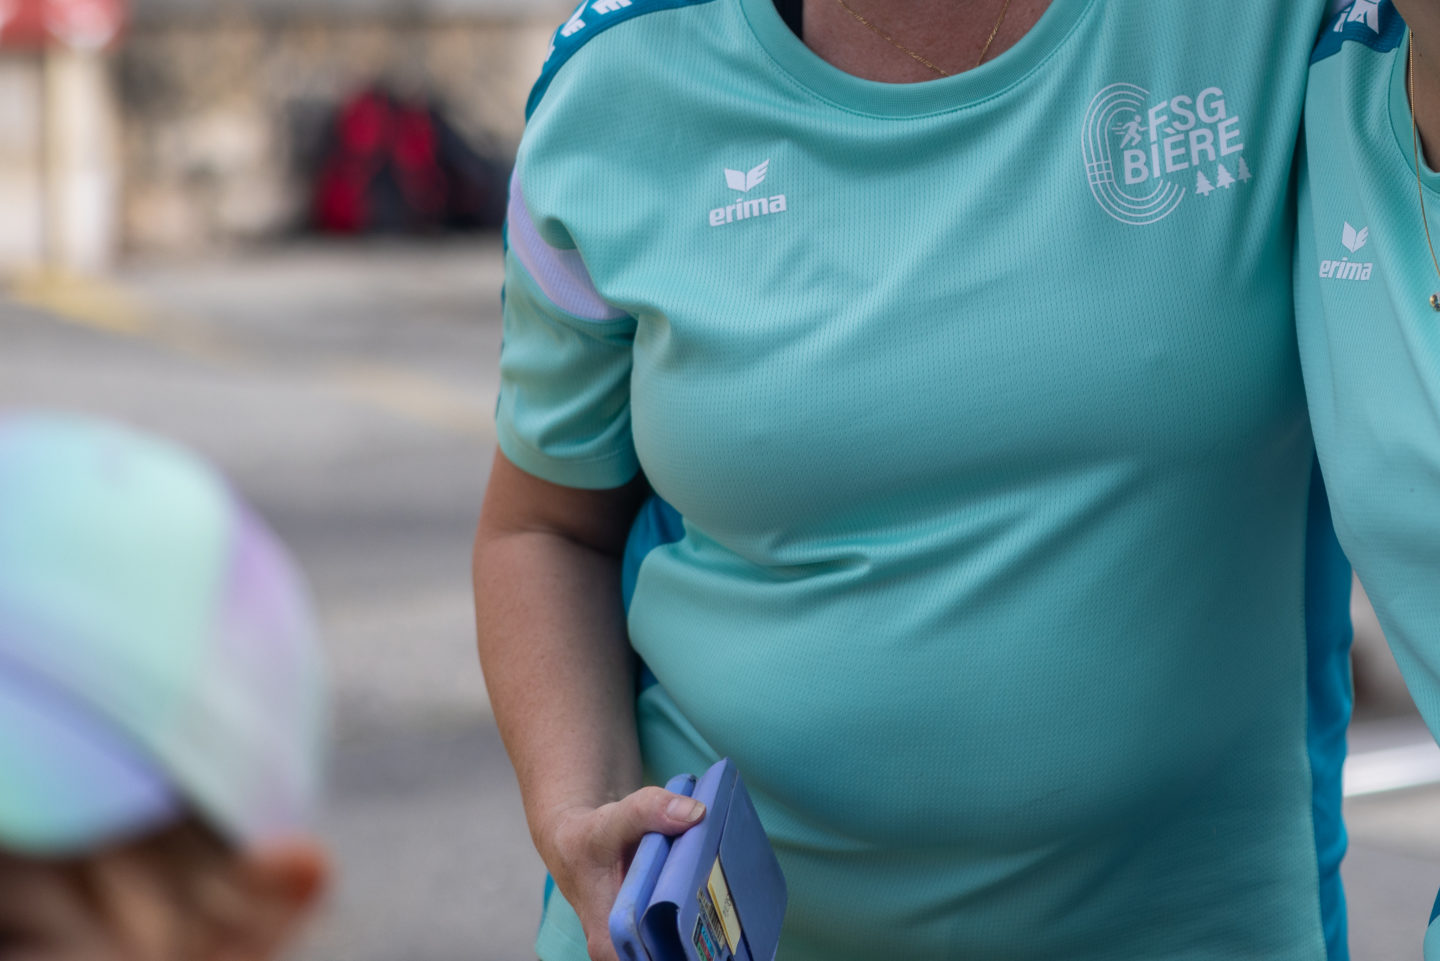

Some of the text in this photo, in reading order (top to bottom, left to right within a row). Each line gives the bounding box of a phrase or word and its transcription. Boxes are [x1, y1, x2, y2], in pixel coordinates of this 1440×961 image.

[1148, 86, 1227, 143] FSG
[1123, 115, 1244, 185] BIÈRE
[709, 194, 787, 227] erima
[1319, 256, 1373, 281] erima
